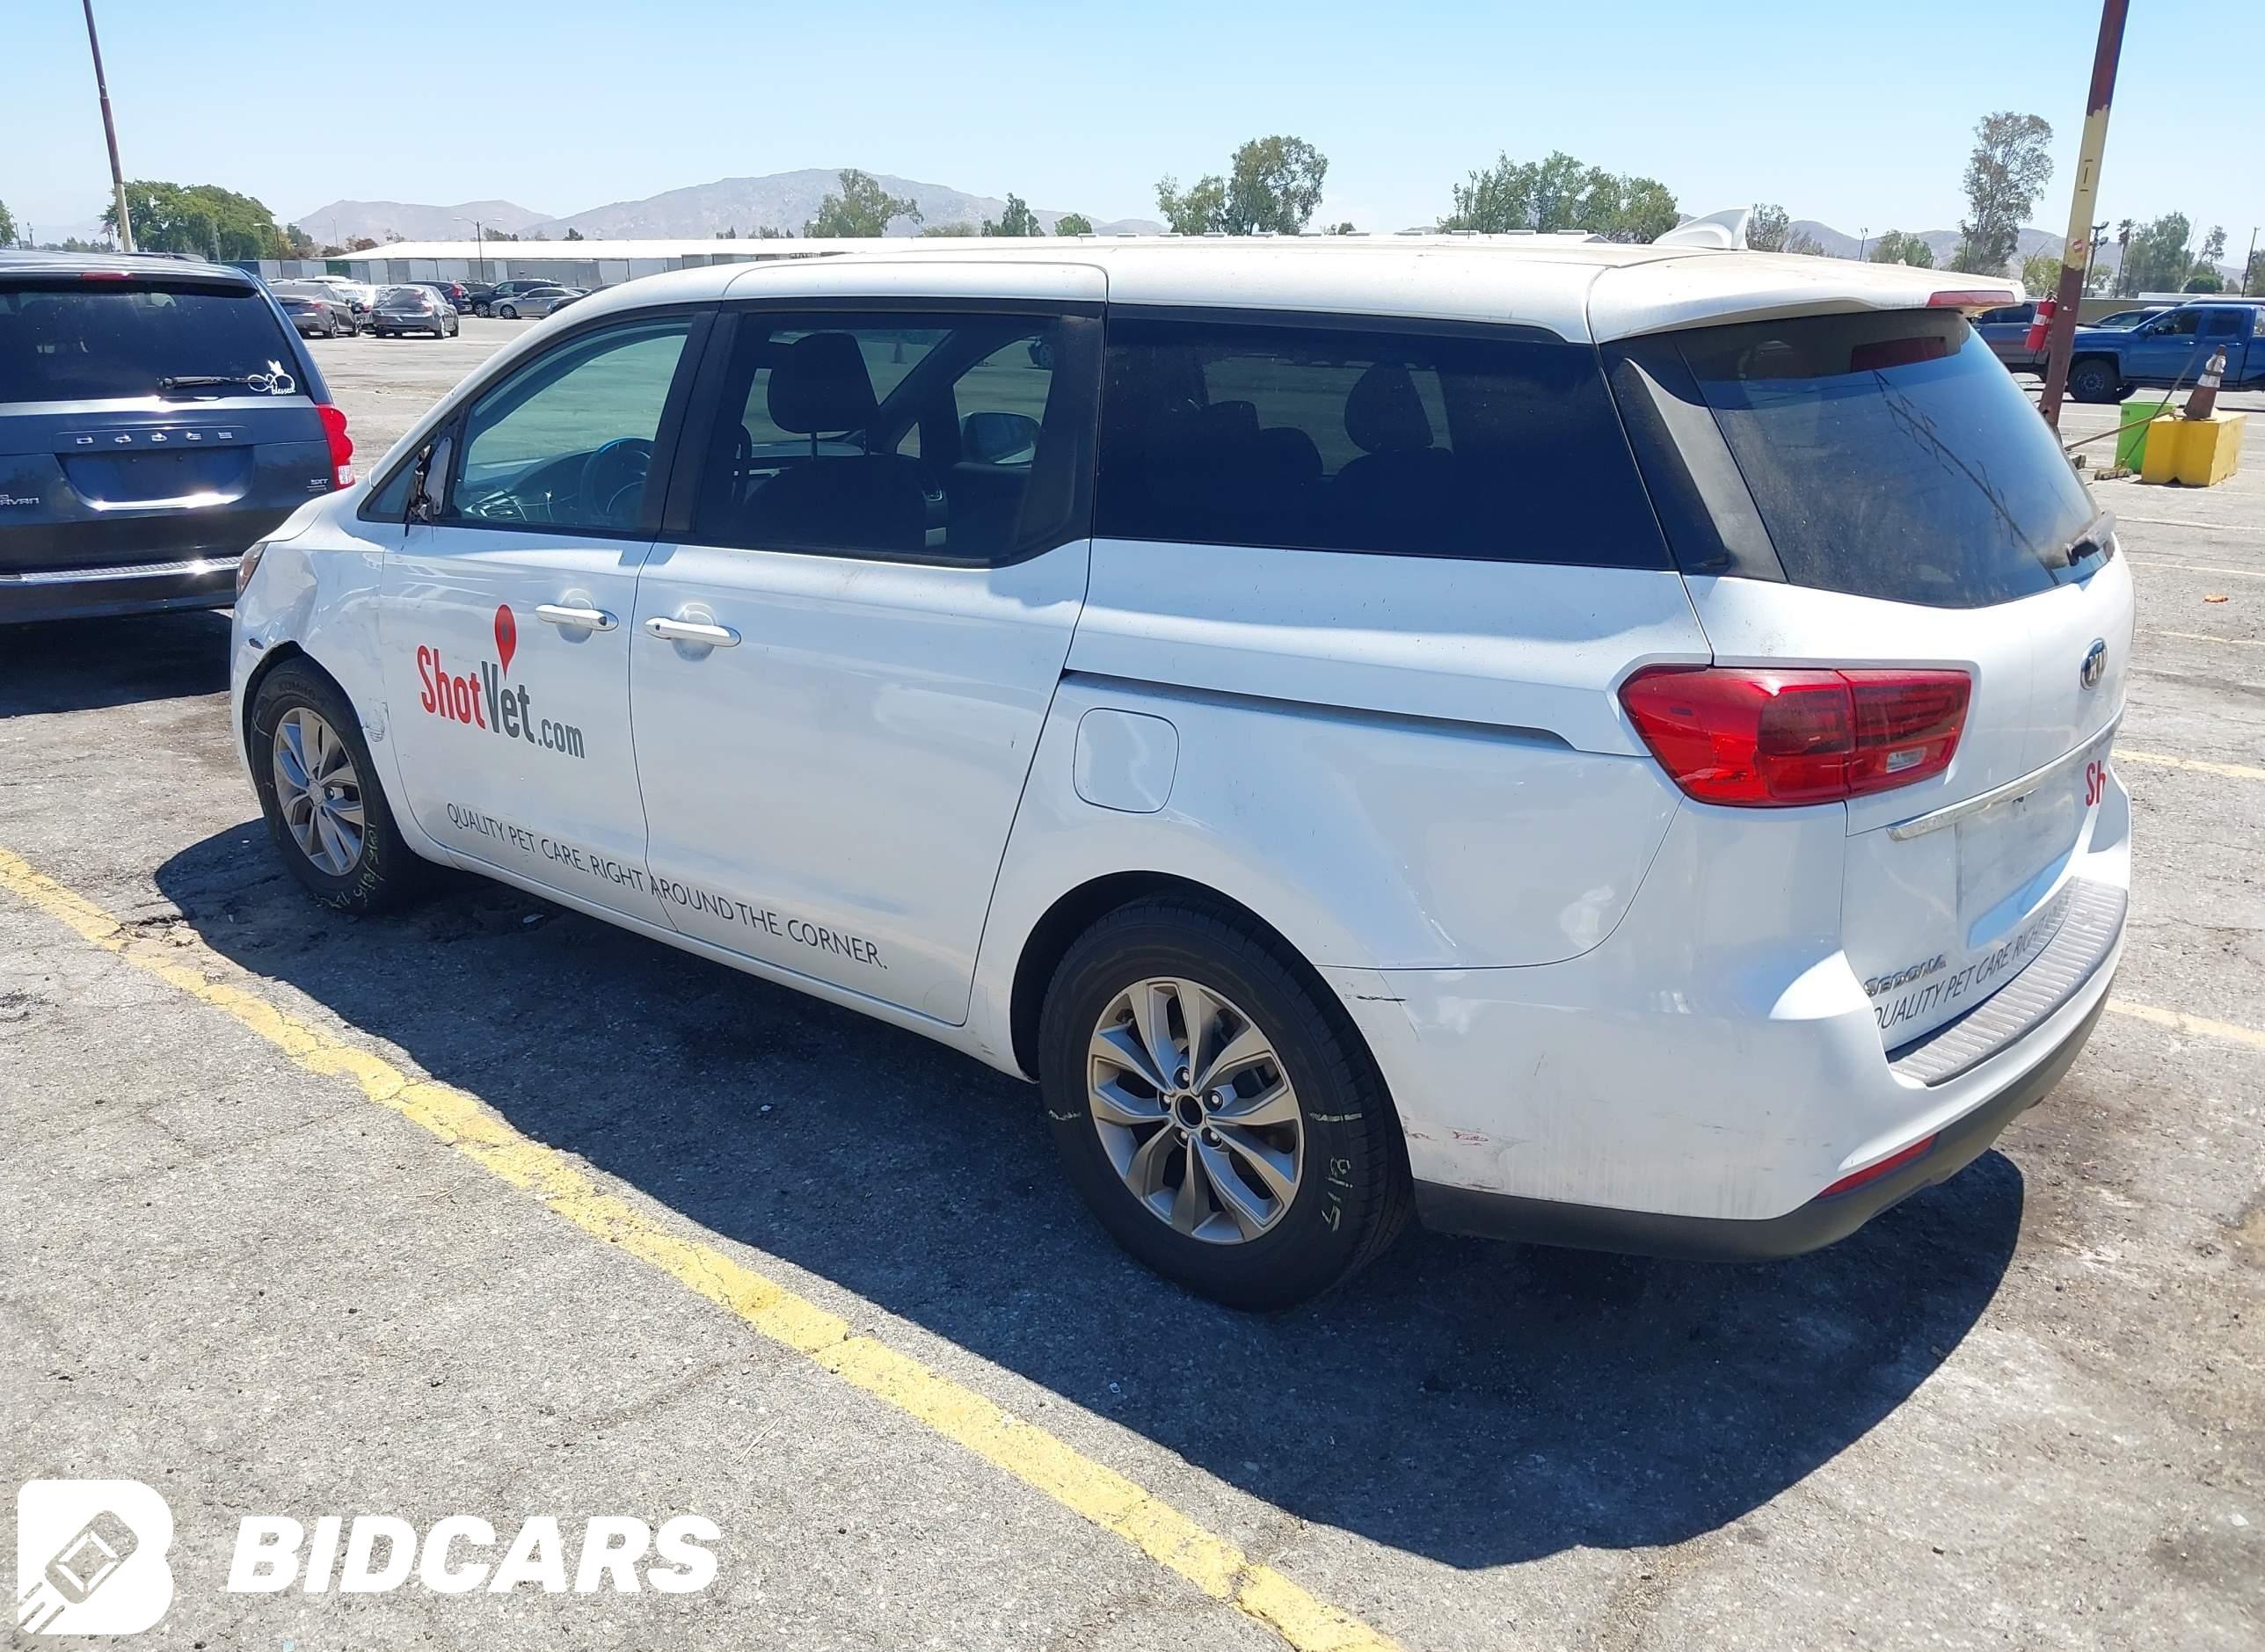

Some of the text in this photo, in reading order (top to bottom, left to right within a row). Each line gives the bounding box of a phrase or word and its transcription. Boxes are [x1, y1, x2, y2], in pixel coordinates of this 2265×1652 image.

[271, 384, 295, 396] blessed
[76, 431, 233, 445] DODGE
[417, 645, 586, 759] ShotVet.com
[447, 803, 888, 970] QUALITY PET CARE. RIGHT AROUND THE CORNER.
[1944, 964, 1977, 1003] PET
